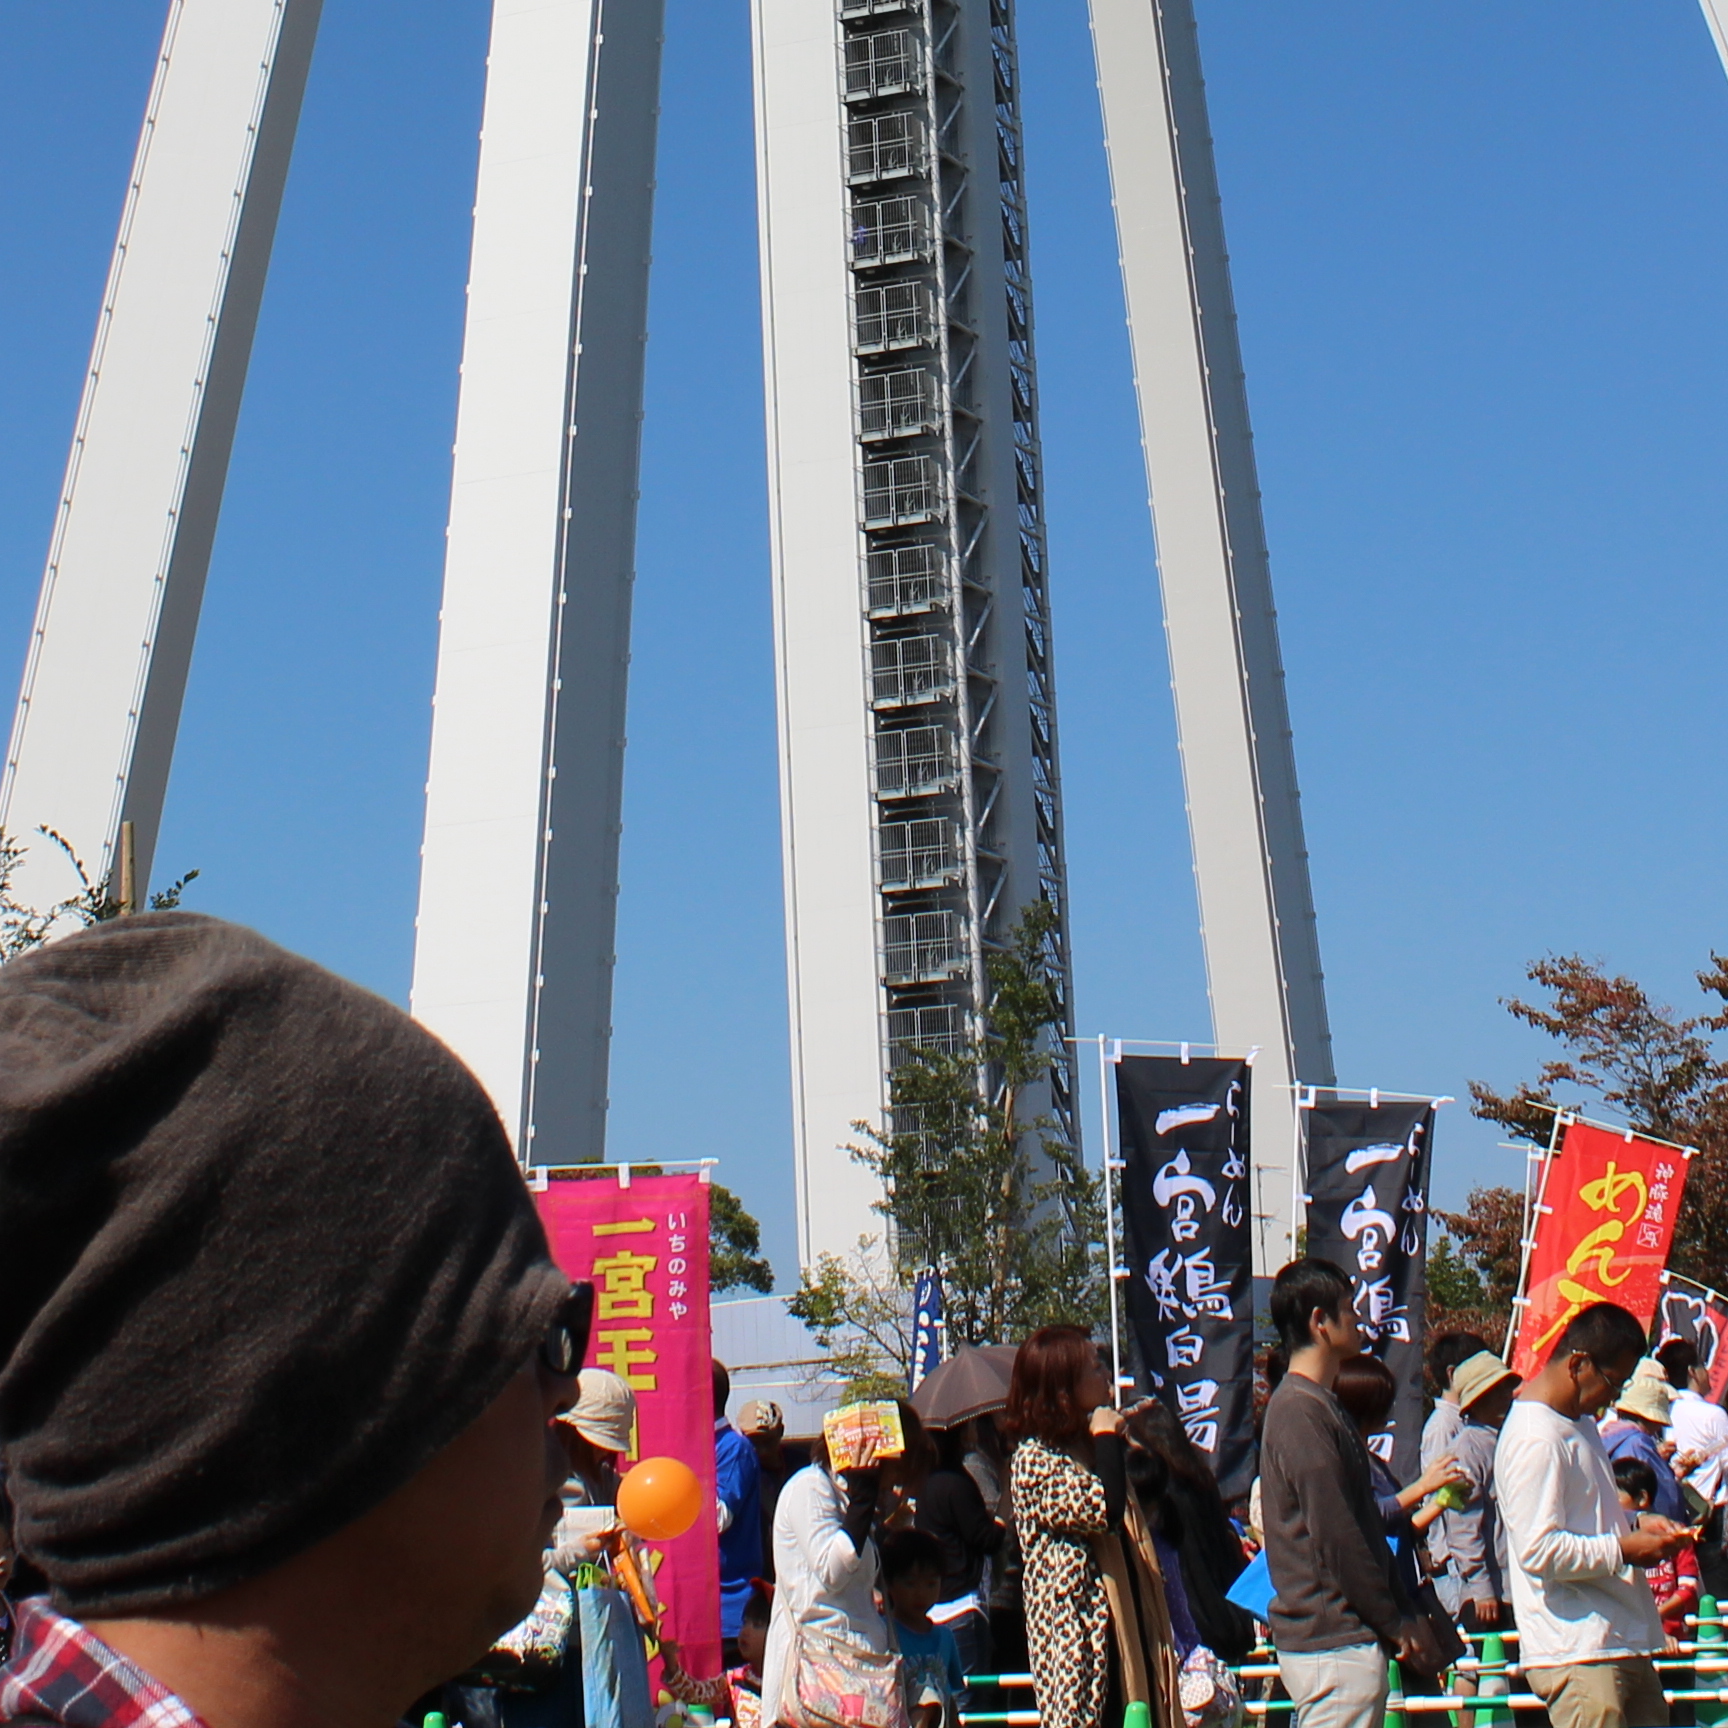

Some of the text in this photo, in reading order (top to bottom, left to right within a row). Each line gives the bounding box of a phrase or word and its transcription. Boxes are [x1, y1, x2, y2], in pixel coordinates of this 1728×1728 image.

[1221, 1080, 1246, 1228] らーめん
[1402, 1122, 1424, 1256] らーめん
[667, 1212, 688, 1320] いちのみや
